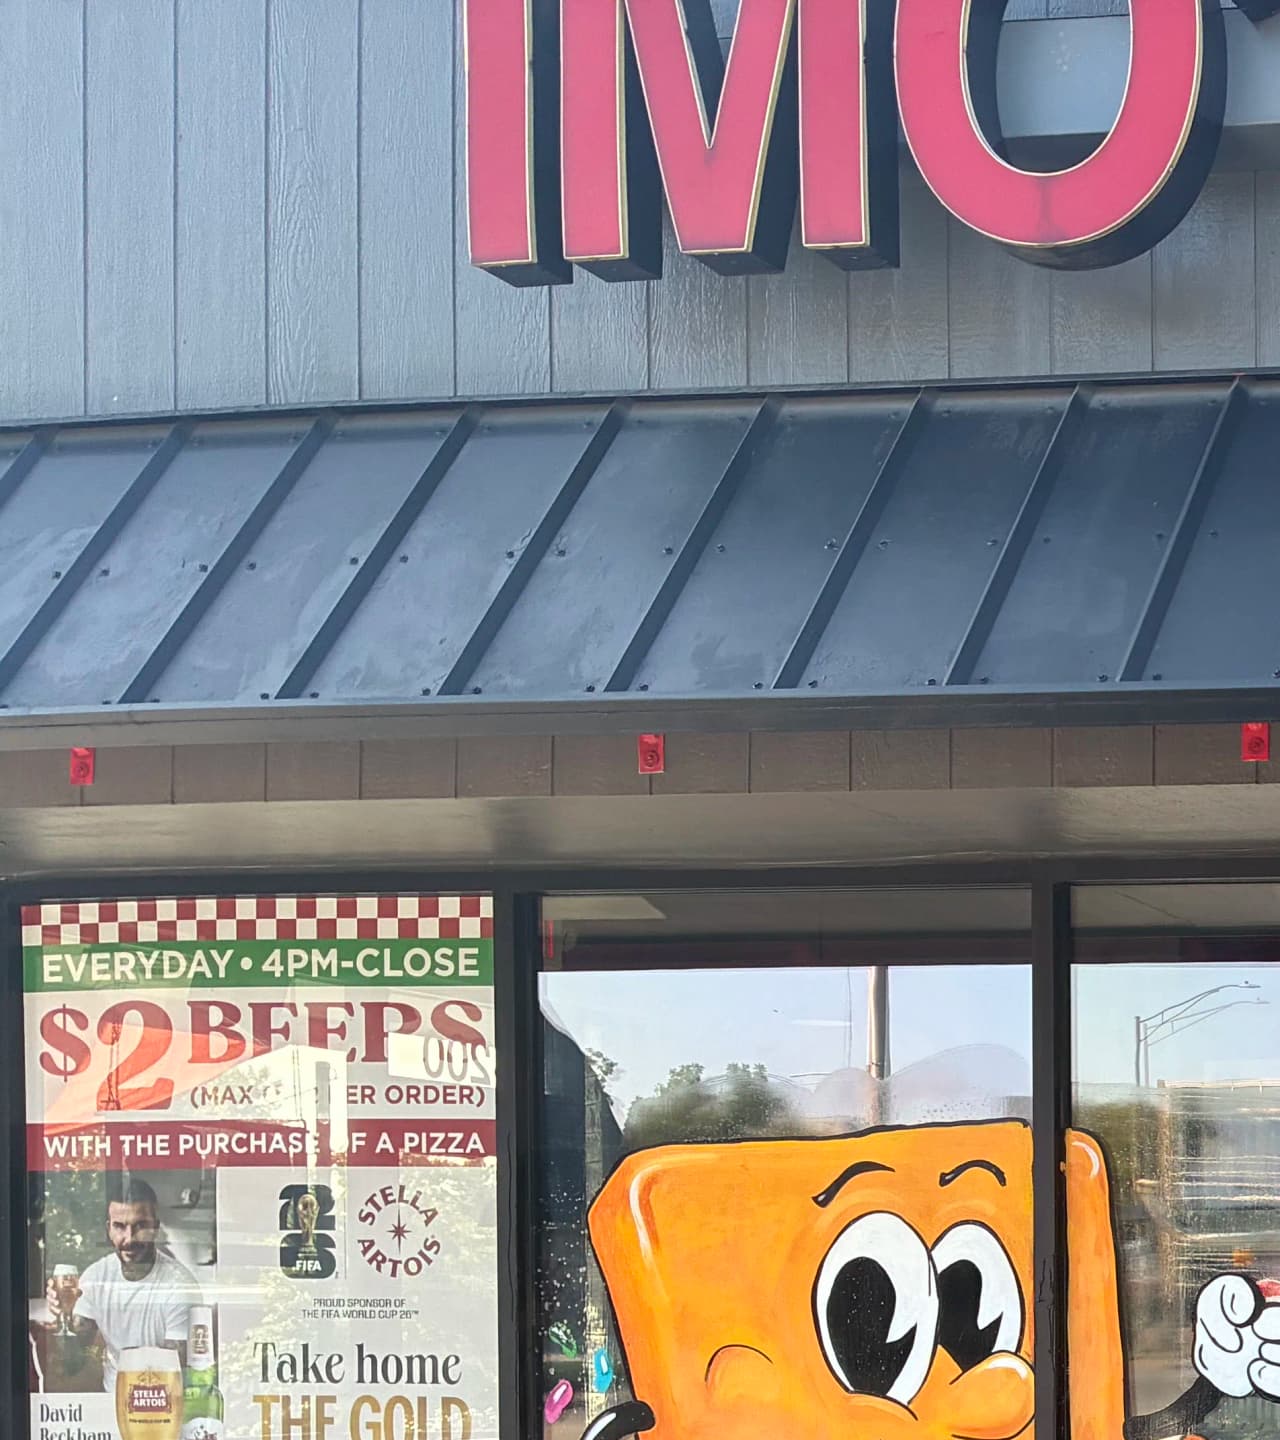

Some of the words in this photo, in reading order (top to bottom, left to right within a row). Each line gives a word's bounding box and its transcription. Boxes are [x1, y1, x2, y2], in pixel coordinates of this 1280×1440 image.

[43, 949, 234, 983] EVERYDAY
[262, 947, 480, 978] 4PM-CLOSE
[40, 1001, 174, 1111] $2
[385, 1084, 485, 1108] ORDER)
[44, 1134, 111, 1158] WITH
[121, 1134, 170, 1156] THE
[180, 1132, 321, 1156] PURCHASE
[376, 1132, 394, 1154] A
[404, 1132, 485, 1153] PIZZA
[358, 1184, 438, 1227] STELLA
[295, 1261, 322, 1271] FIFA
[357, 1236, 441, 1278] ARTOIS
[302, 1310, 319, 1319] THE
[321, 1310, 340, 1319] FIFA
[343, 1310, 376, 1319] WORLD
[378, 1310, 398, 1319] CUP
[313, 1299, 345, 1308] PROUD
[347, 1299, 392, 1308] SPONSOR
[394, 1299, 406, 1308] OF
[252, 1342, 346, 1385] Take
[357, 1342, 462, 1385] home
[133, 1390, 167, 1398] STELLA
[133, 1398, 167, 1407] ARTOIS
[40, 1403, 82, 1422] David
